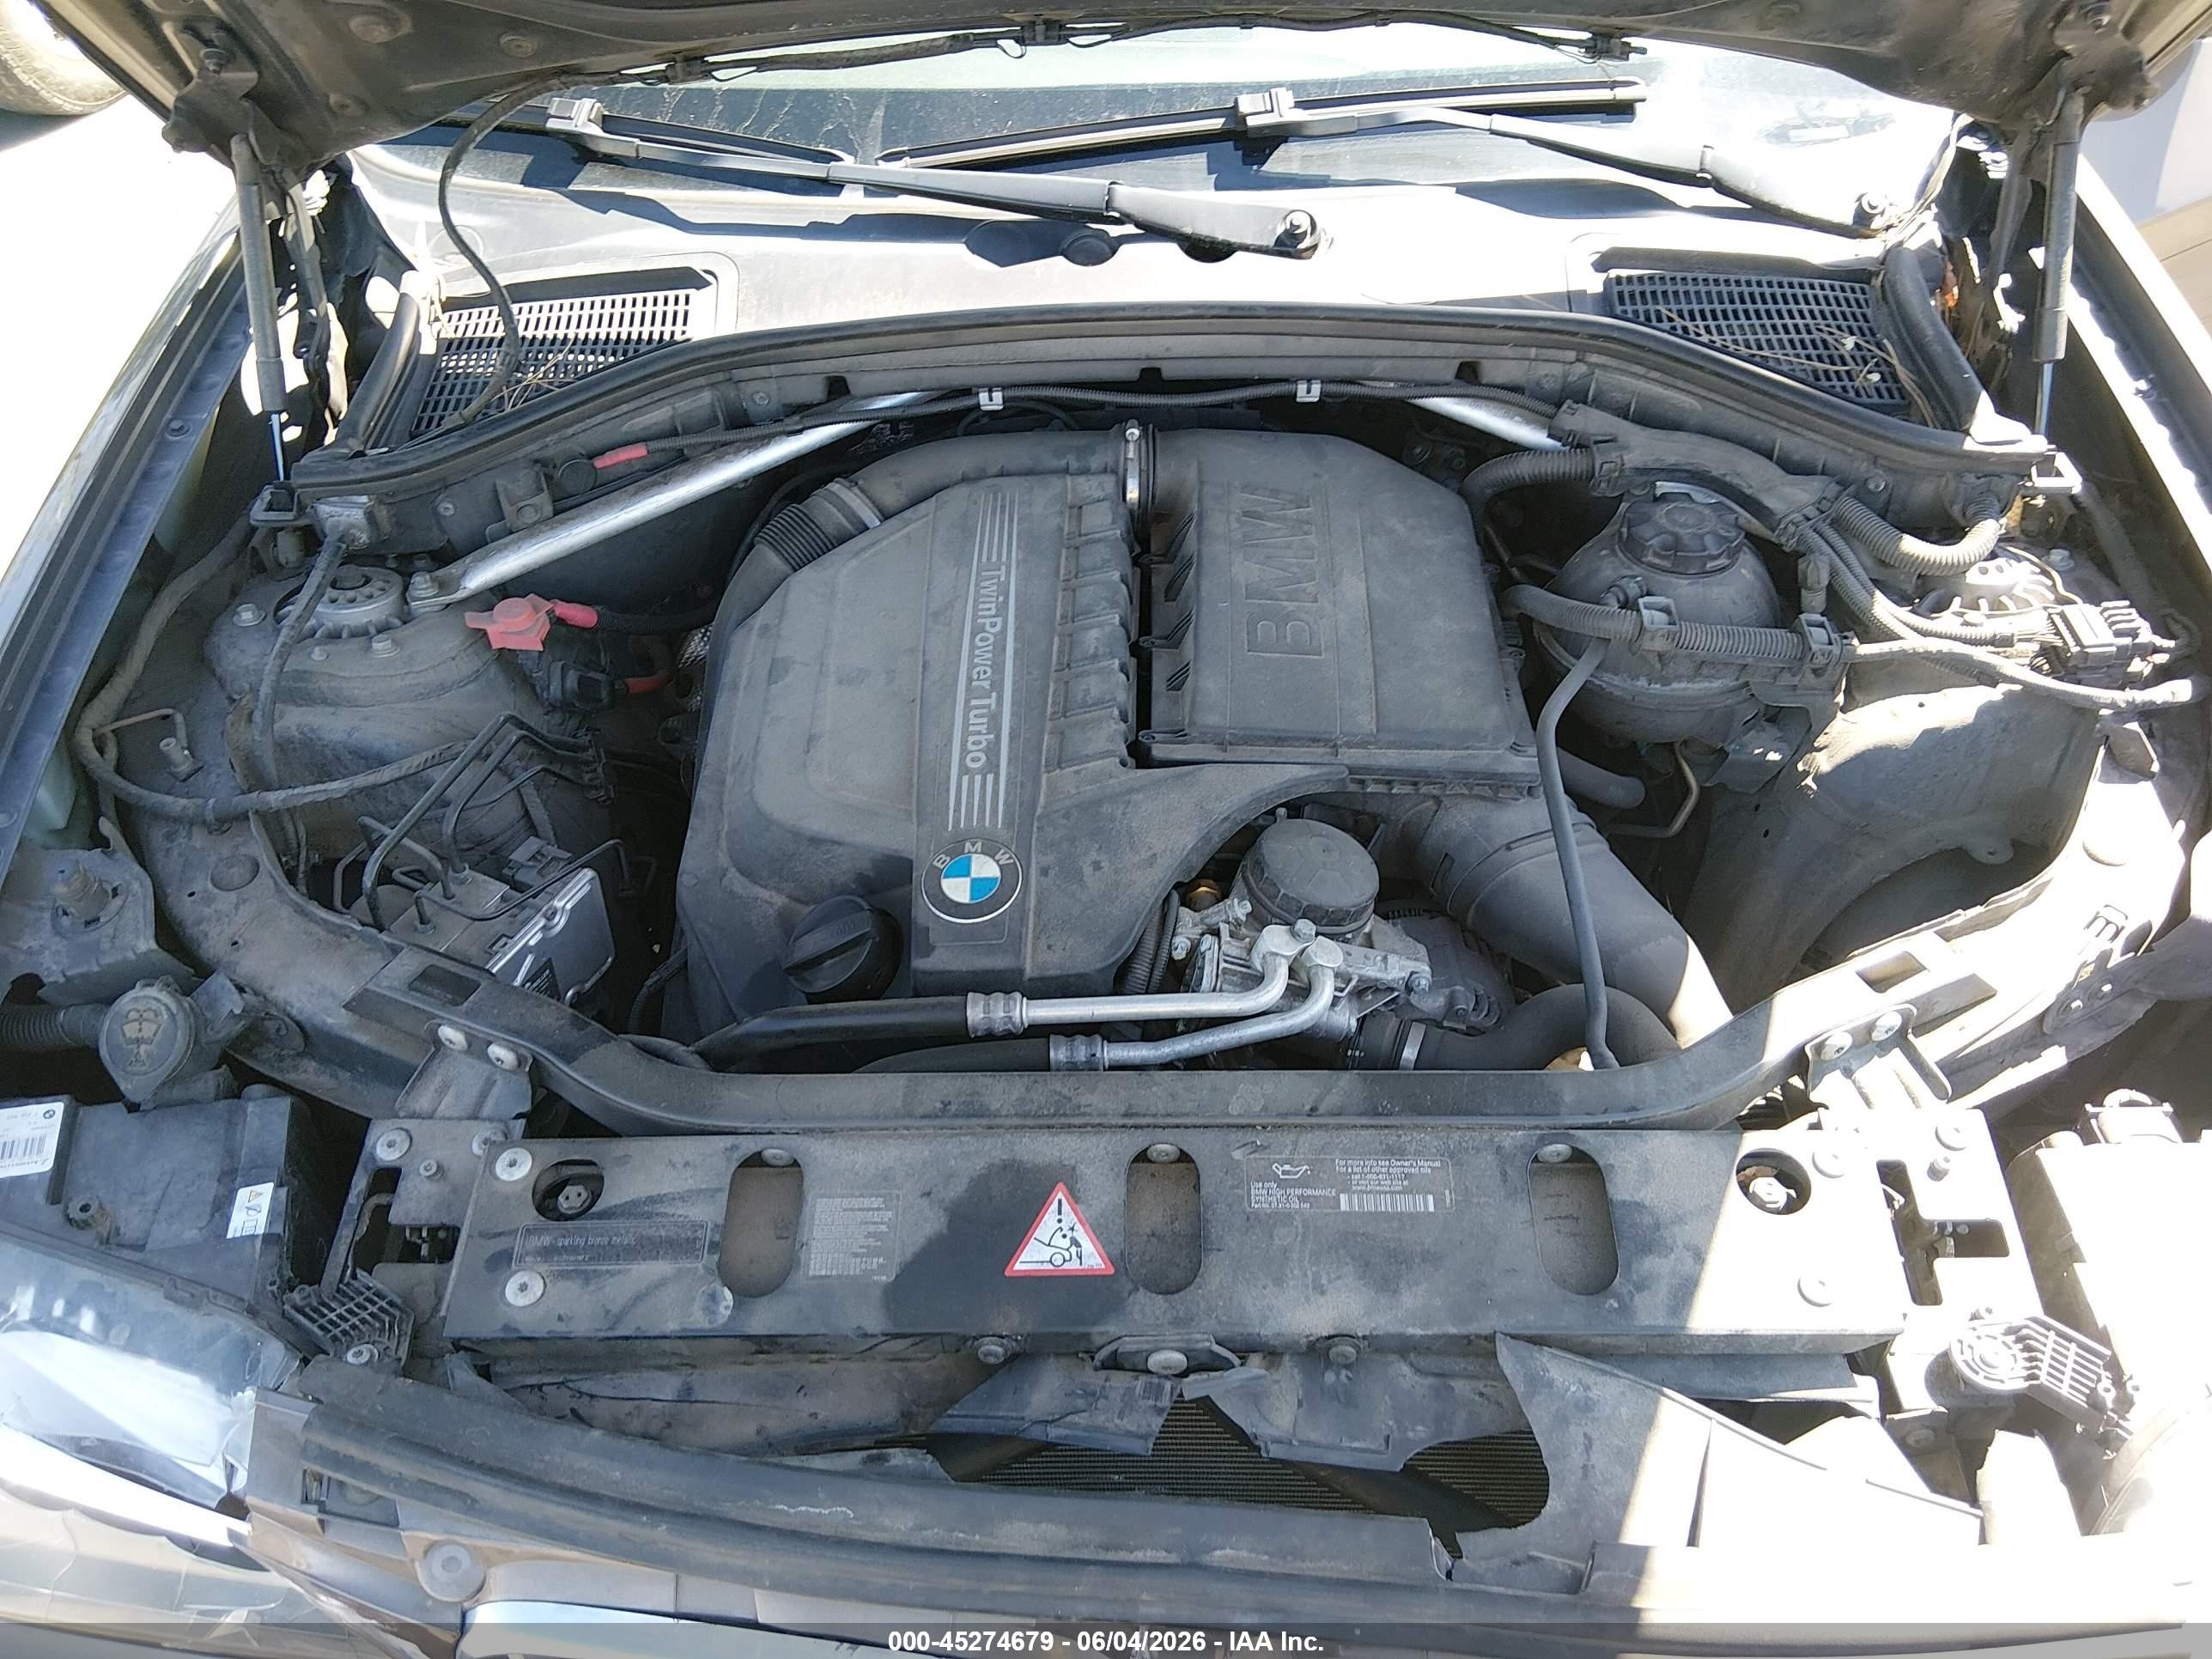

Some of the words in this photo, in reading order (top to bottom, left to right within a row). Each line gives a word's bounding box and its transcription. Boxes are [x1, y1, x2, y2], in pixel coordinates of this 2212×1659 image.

[1241, 486, 1325, 659] BMW
[971, 565, 1006, 689] TwinPower
[965, 692, 996, 769] Turbo
[932, 842, 1014, 869] BMW
[1264, 1181, 1277, 1189] only
[1286, 1188, 1336, 1196] PERFORMANCE
